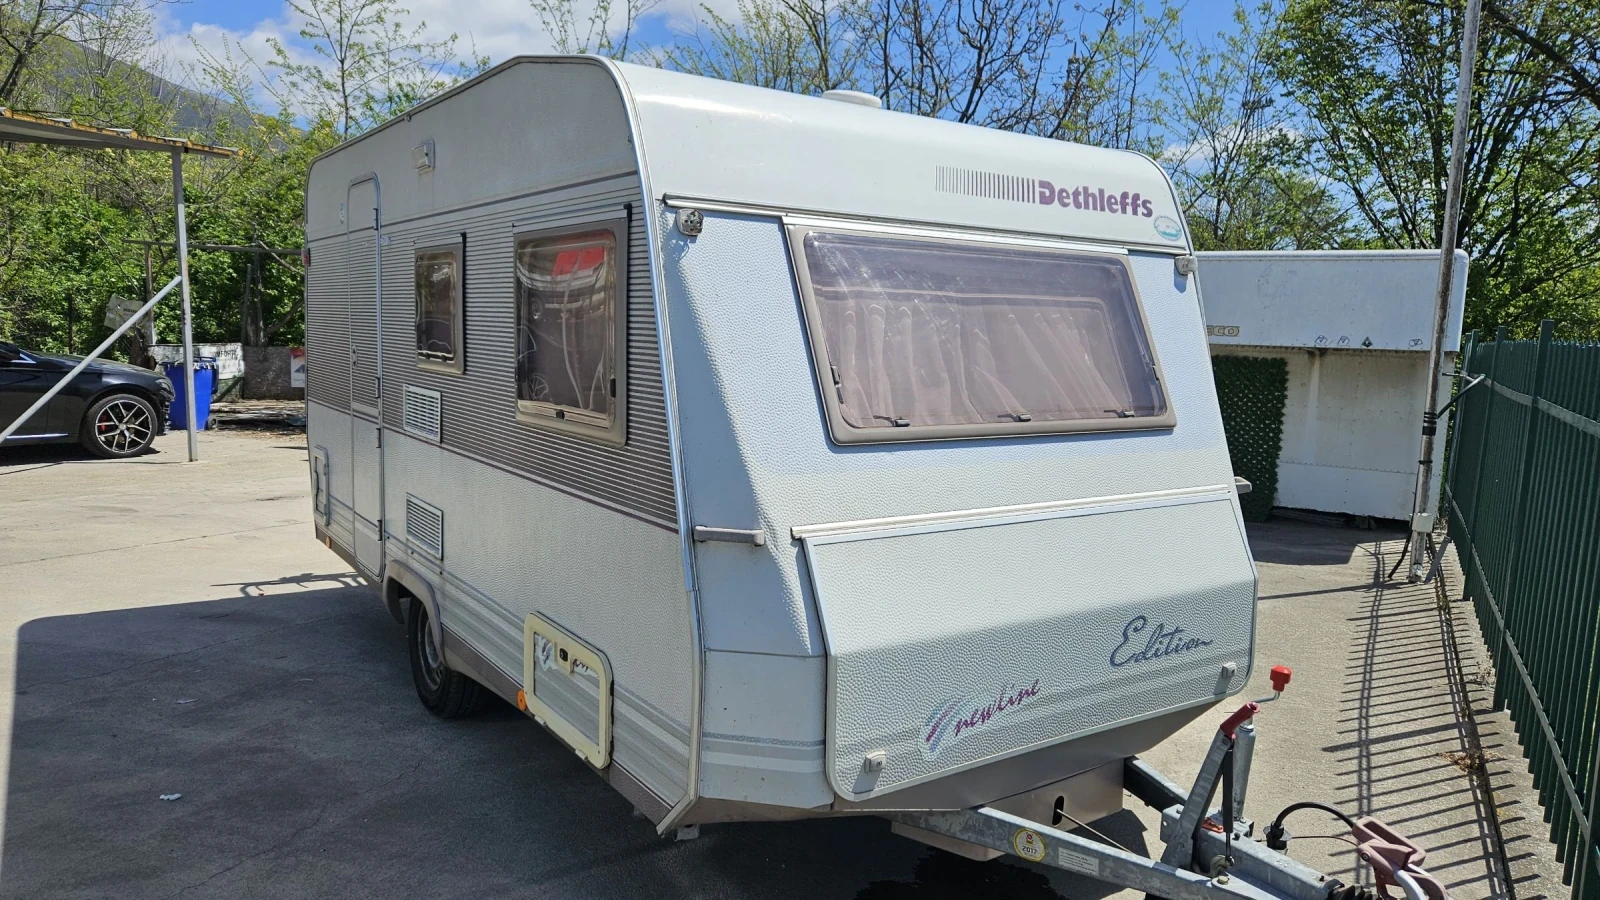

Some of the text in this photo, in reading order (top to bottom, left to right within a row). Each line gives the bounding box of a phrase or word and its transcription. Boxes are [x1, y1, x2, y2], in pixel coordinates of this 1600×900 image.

[1038, 180, 1153, 218] Dethleffs
[1110, 615, 1213, 666] Edition
[955, 679, 1040, 736] newline
[1022, 845, 1037, 854] 2017
